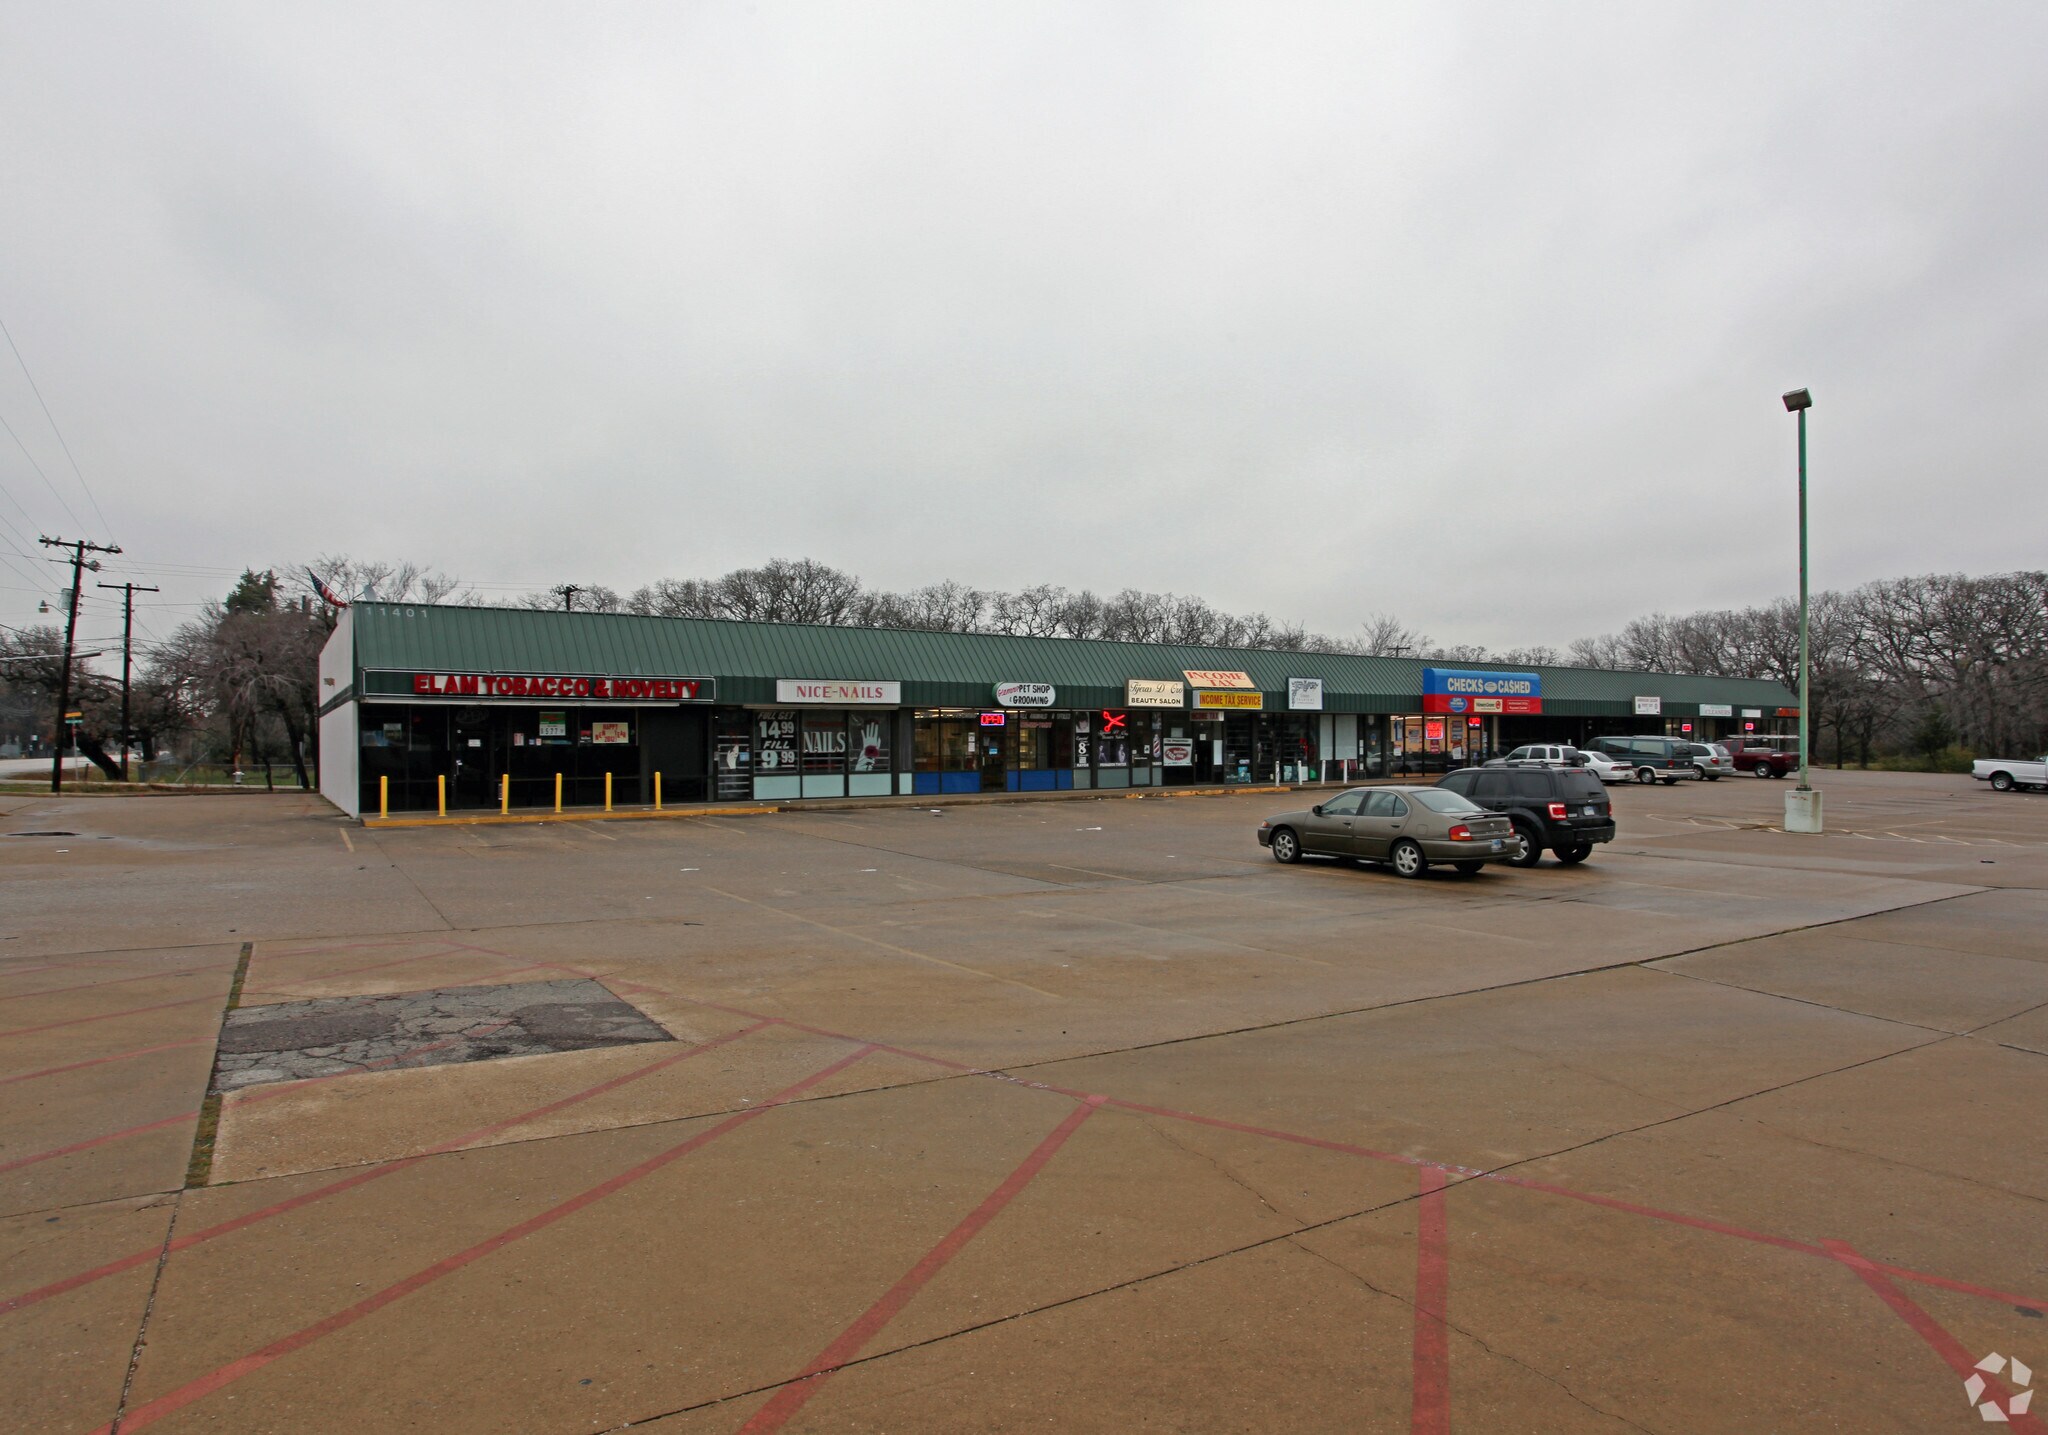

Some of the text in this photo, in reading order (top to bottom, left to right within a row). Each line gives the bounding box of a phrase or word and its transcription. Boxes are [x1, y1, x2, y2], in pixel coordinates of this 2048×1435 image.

[364, 606, 429, 619] 11401
[1187, 671, 1246, 681] INCOME
[413, 673, 701, 700] ELAM TOBACCO & NOVELTY
[1208, 679, 1236, 687] TAX
[1018, 684, 1031, 693] PET
[1032, 684, 1051, 694] SHOP
[1013, 696, 1050, 705] GROOMING
[1199, 694, 1262, 706] INCOME TAX SERVICE
[982, 714, 1004, 725] OPEN
[763, 740, 791, 750] FILL
[803, 731, 846, 754] NAILS
